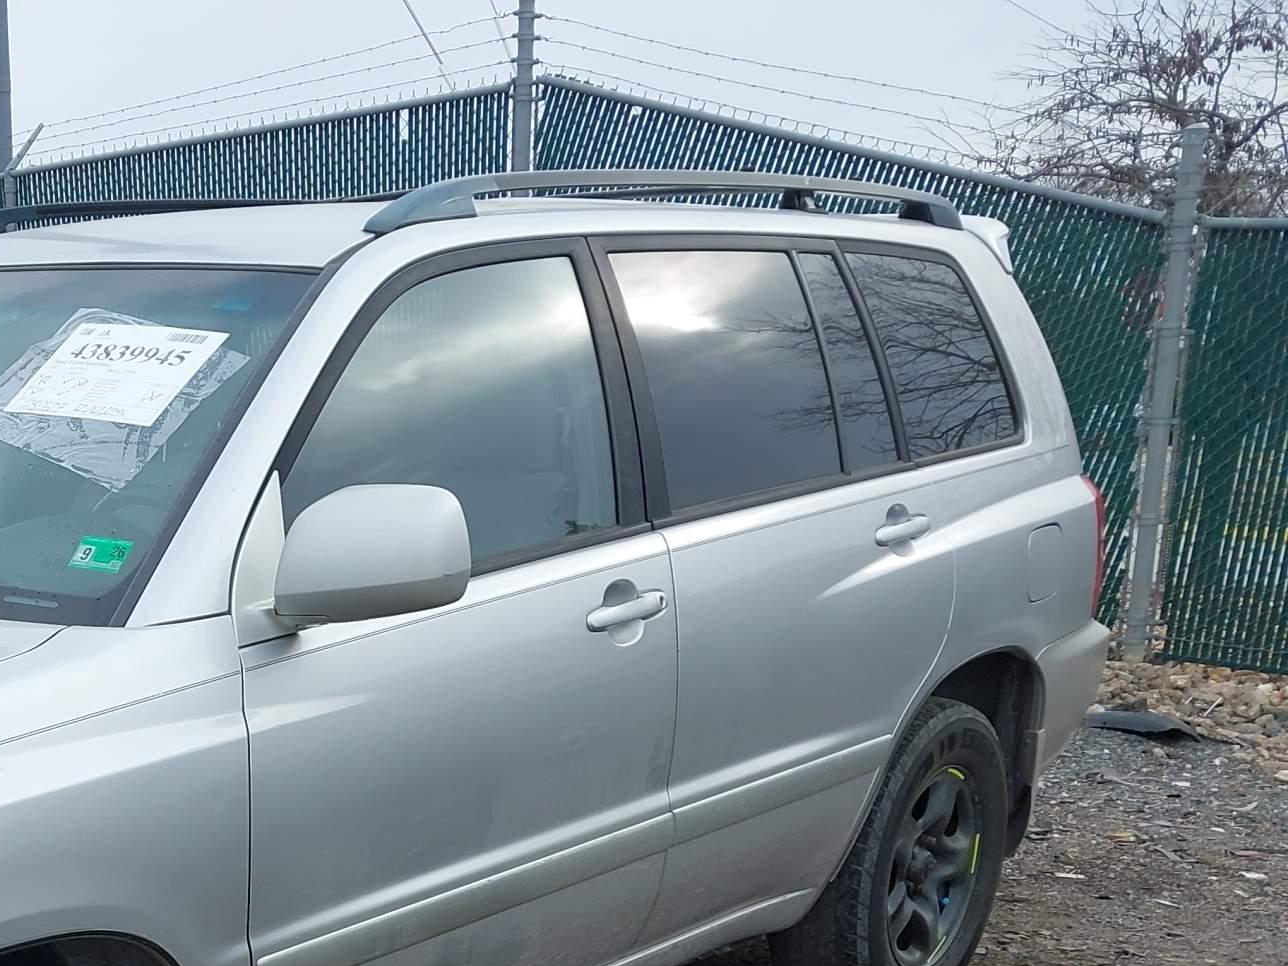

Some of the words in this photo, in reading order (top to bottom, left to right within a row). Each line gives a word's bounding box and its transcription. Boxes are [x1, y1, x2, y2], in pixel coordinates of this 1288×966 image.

[70, 342, 193, 367] 43839945
[80, 547, 93, 561] 9
[110, 545, 127, 559] 26
